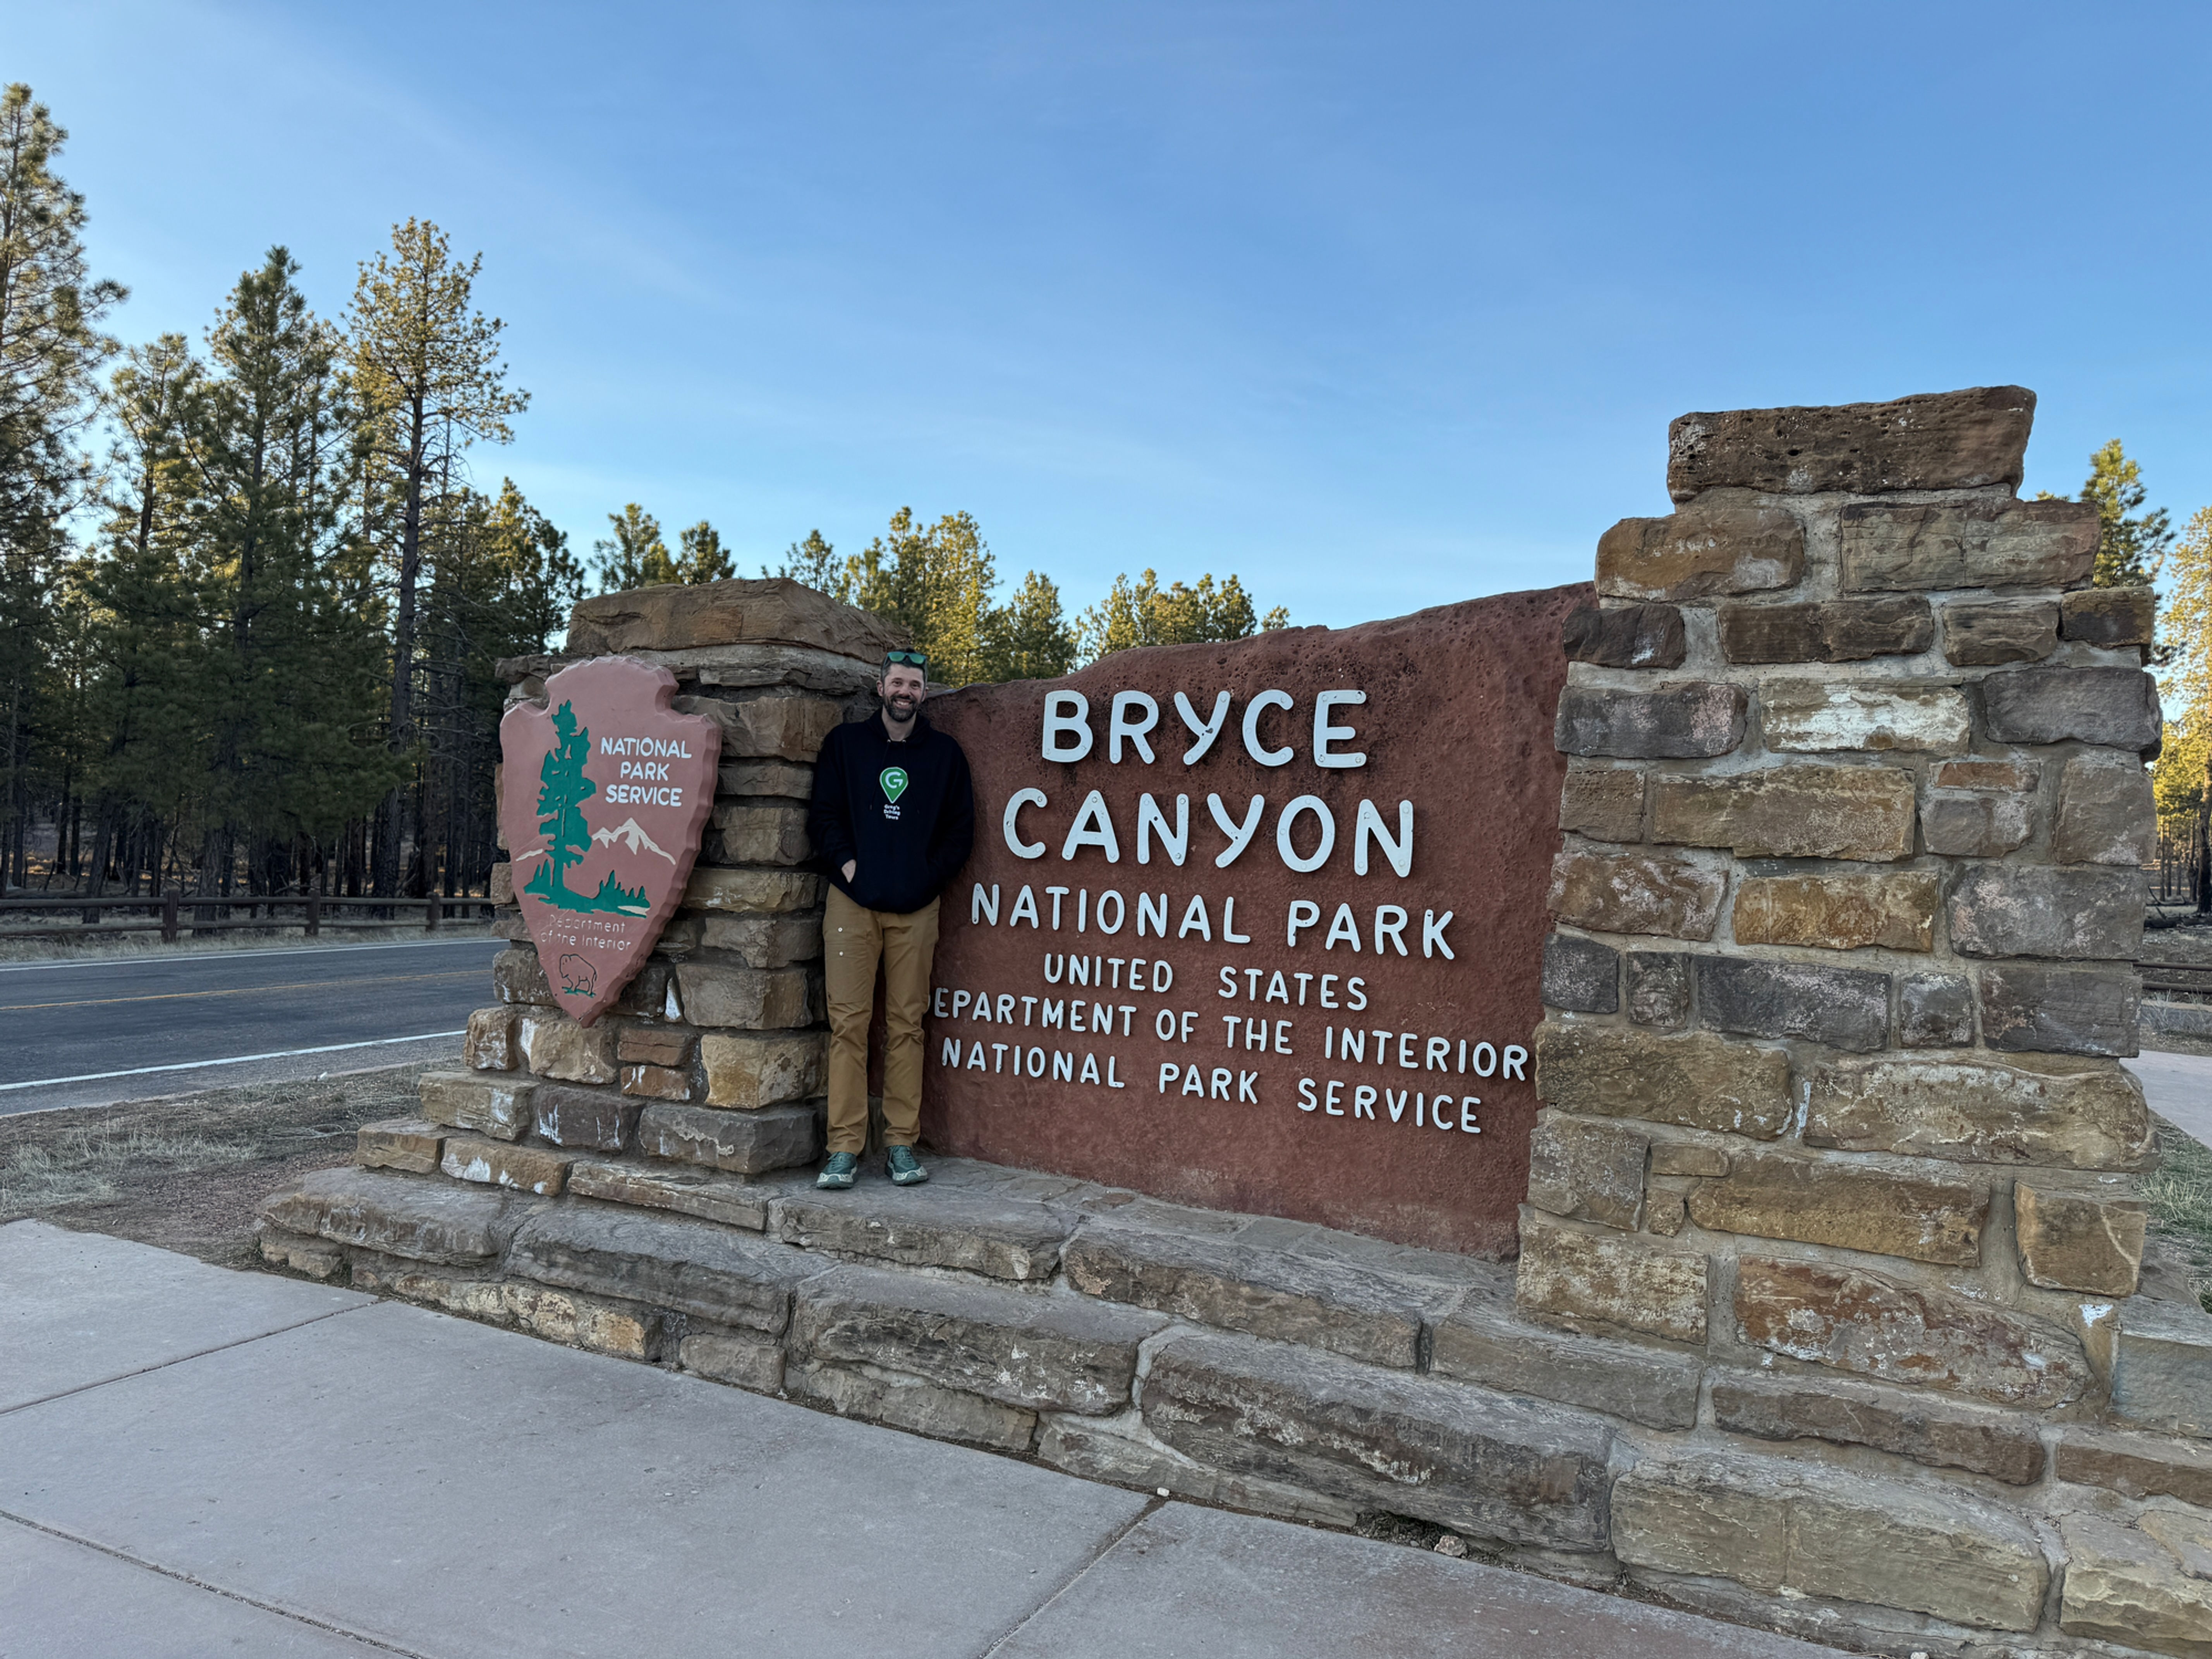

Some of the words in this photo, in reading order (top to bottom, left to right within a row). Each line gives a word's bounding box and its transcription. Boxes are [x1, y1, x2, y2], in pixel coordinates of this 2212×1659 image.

[601, 737, 692, 759] NATIONAL
[1041, 689, 1367, 768] BRYCE
[605, 784, 683, 807] SERVICE
[620, 761, 670, 781] PARK
[885, 771, 903, 788] G
[1003, 787, 1413, 878] CANYON
[541, 930, 553, 943] of
[557, 933, 576, 946] the
[582, 934, 631, 951] Interior
[972, 883, 1251, 944] NATIONAL
[1287, 900, 1455, 960] PARK
[1044, 953, 1173, 993] UNITED
[1218, 966, 1367, 1011] STATES
[928, 987, 1137, 1037] EPARTMENT
[1155, 1008, 1199, 1043] OF
[1222, 1015, 1293, 1055] THE
[1325, 1026, 1528, 1081] INTERIOR
[942, 1037, 1125, 1088] NATIONAL
[1159, 1062, 1258, 1105] PARK
[1297, 1077, 1481, 1133] SERVICE
